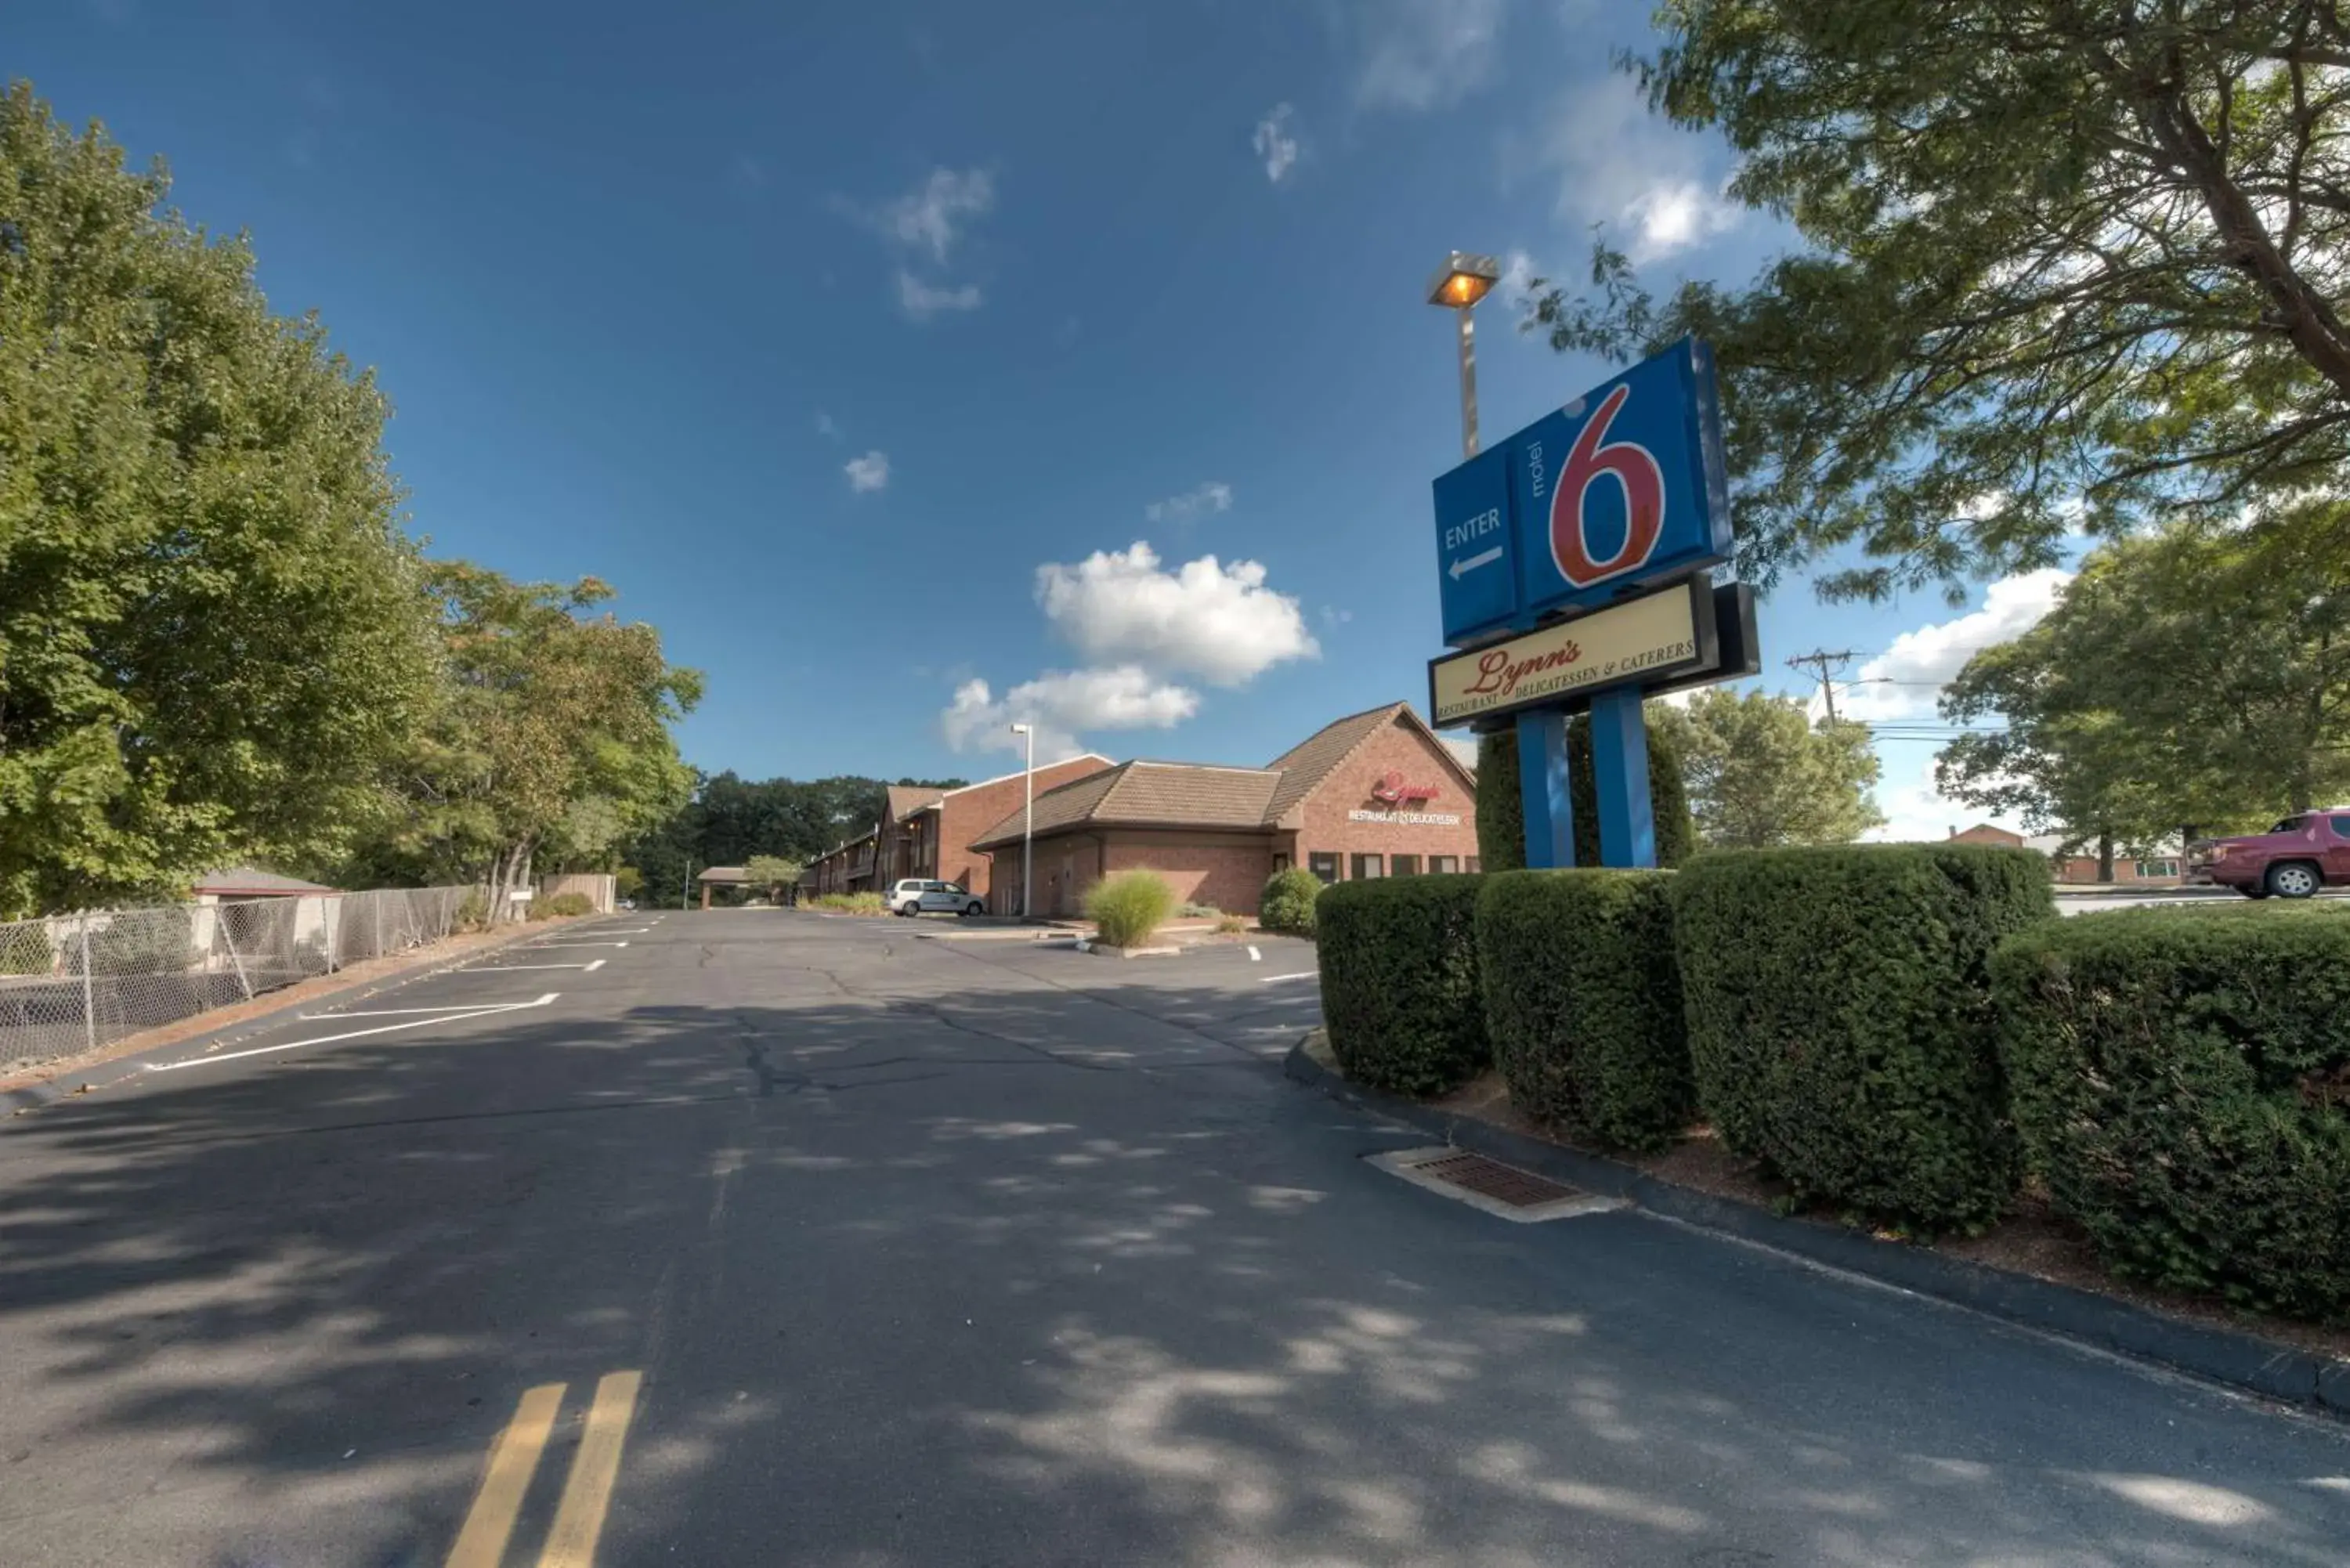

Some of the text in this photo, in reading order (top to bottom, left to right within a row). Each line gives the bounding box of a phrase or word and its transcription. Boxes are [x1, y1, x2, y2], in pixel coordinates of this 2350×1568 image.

[1528, 383, 1665, 589] motel 6
[1445, 508, 1501, 550] ENTER
[1438, 639, 1694, 717] RESTAURANT DELICATESSEN & CATERERS
[1462, 639, 1582, 695] Lynn's
